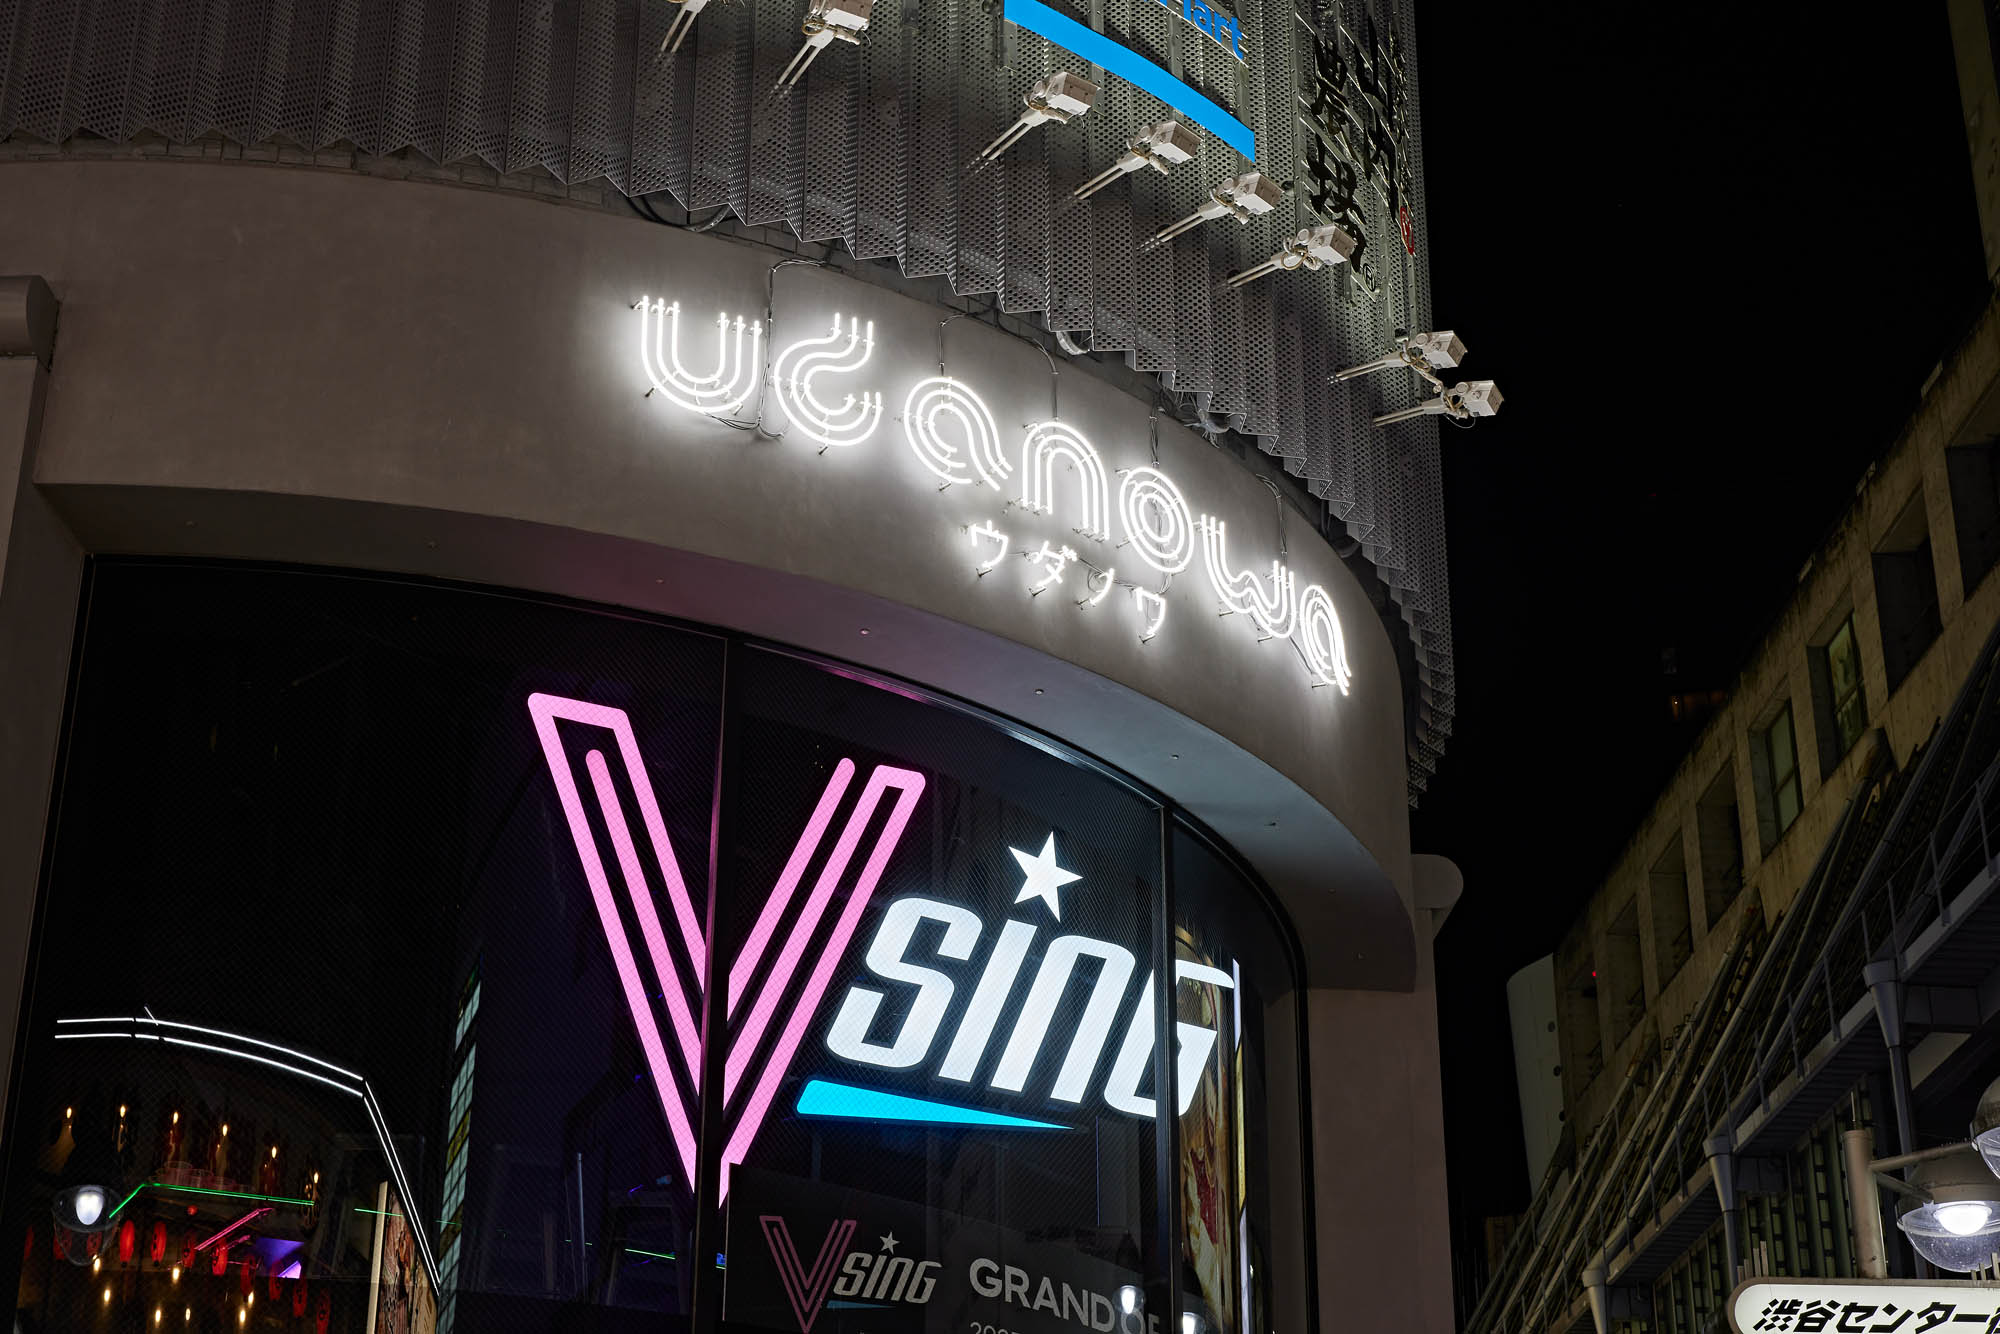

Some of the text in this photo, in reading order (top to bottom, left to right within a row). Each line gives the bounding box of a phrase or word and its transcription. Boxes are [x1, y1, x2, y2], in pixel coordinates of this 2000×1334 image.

[969, 520, 1157, 636] ウダノワ
[968, 1257, 1116, 1333] GRAND
